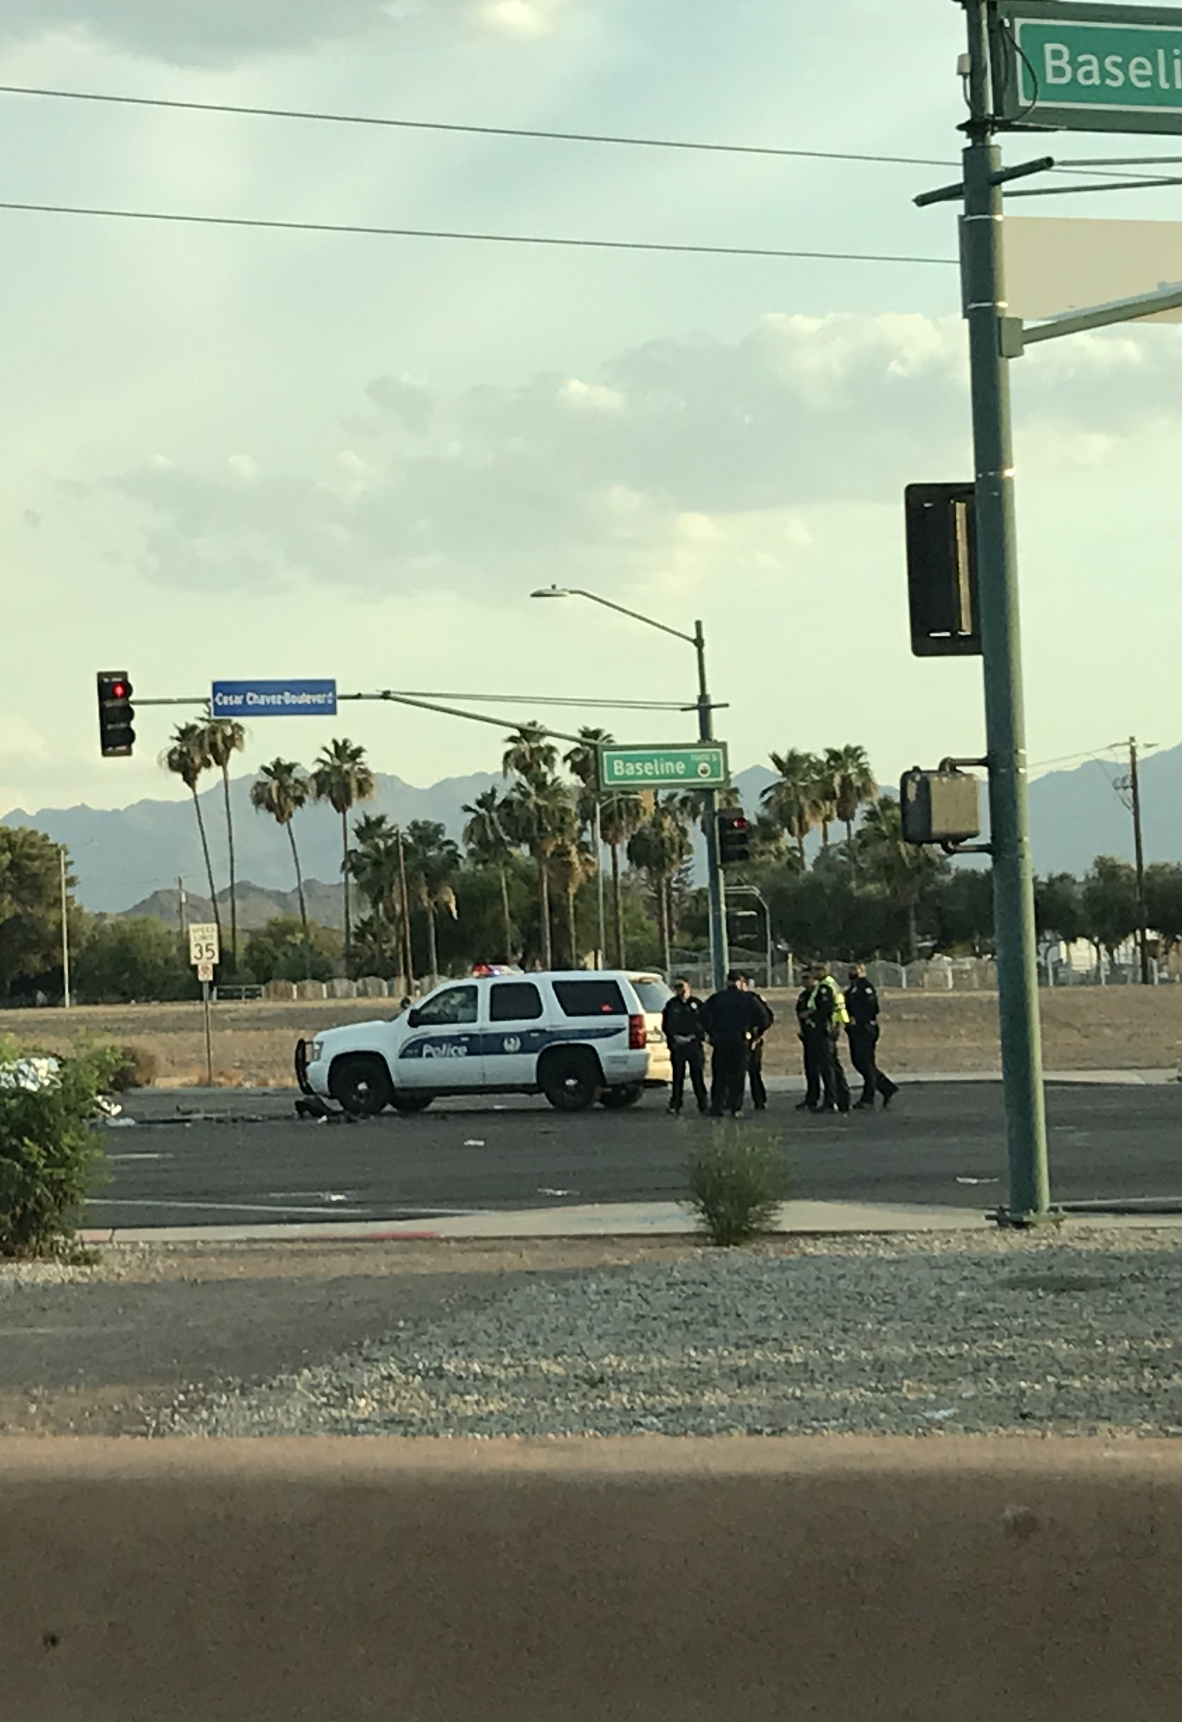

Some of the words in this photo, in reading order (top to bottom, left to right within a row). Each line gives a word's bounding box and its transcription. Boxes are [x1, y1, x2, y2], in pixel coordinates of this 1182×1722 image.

[1044, 43, 1182, 89] Baseli
[215, 692, 244, 706] Cesar
[246, 691, 283, 706] Chavez
[284, 691, 334, 705] Boulevard
[613, 758, 686, 776] Baseline
[193, 942, 216, 961] 35
[422, 1043, 468, 1058] Police
